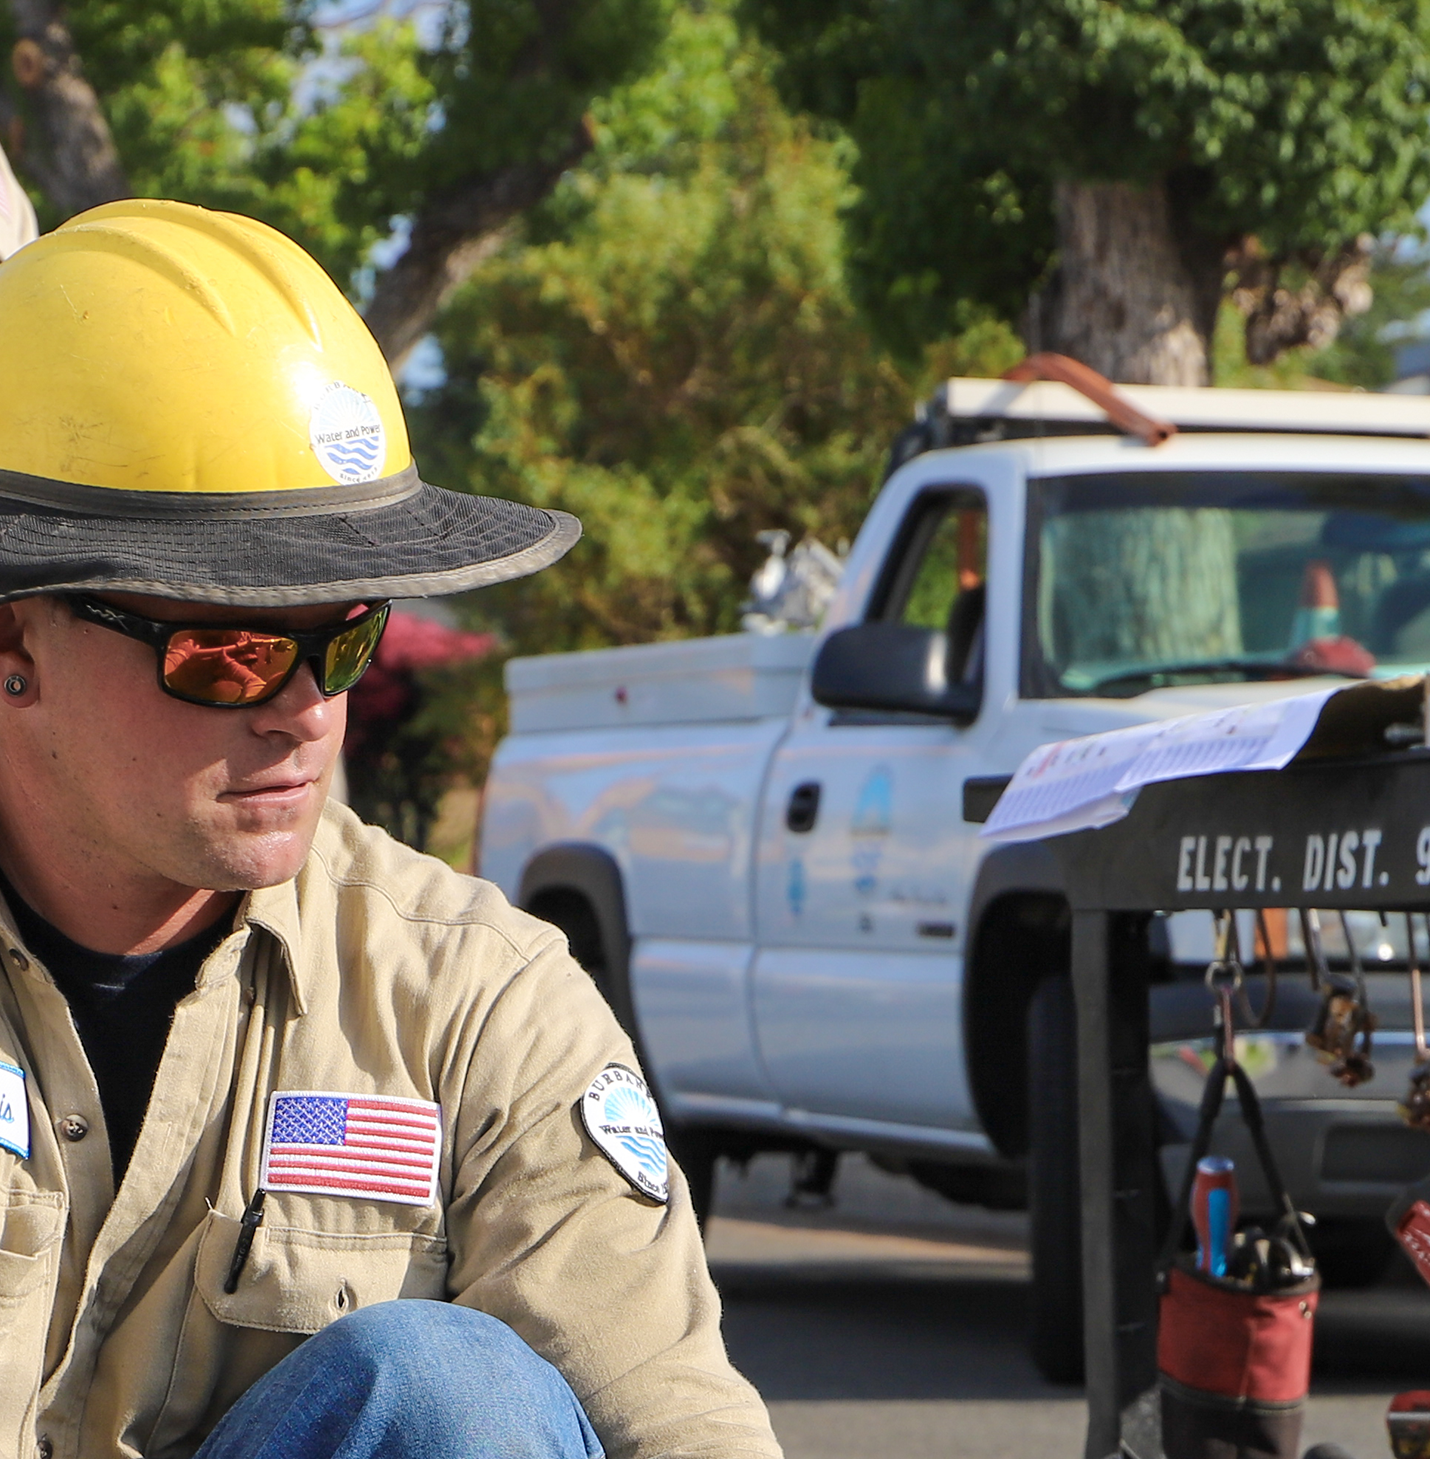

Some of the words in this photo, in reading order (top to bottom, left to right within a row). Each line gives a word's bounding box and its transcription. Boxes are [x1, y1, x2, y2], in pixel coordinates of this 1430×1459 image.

[315, 430, 343, 444] Water
[345, 426, 360, 439] and
[1176, 834, 1281, 891] ELECT.
[1302, 828, 1389, 891] DIST.
